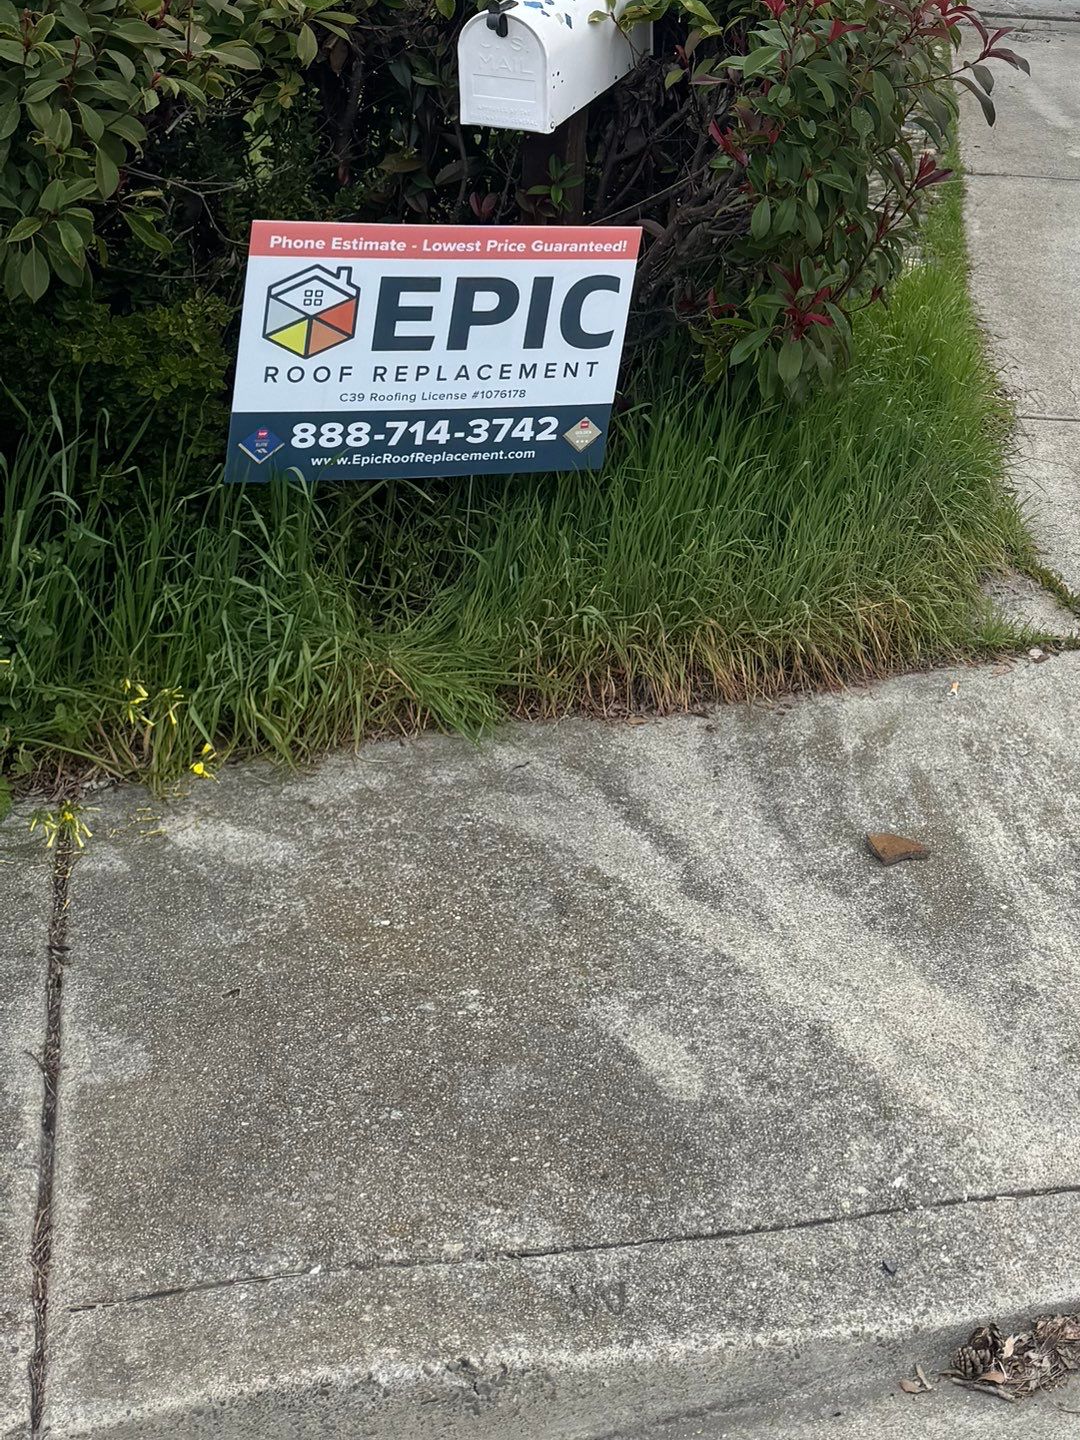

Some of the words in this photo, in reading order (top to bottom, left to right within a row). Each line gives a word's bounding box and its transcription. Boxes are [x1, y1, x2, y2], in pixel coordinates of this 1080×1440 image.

[269, 235, 326, 250] Phone
[331, 237, 407, 252] Estimate
[422, 239, 482, 252] Lowest
[486, 239, 526, 252] Price
[531, 240, 628, 253] Guaranteed!
[371, 274, 621, 351] EPIC
[264, 366, 353, 383] ROOF
[372, 361, 599, 383] REPLACEMENT
[339, 392, 365, 402] C39
[370, 392, 417, 403] Roofing
[421, 391, 467, 401] License
[471, 389, 526, 400] #1076178
[290, 416, 559, 449] 888-714-3742
